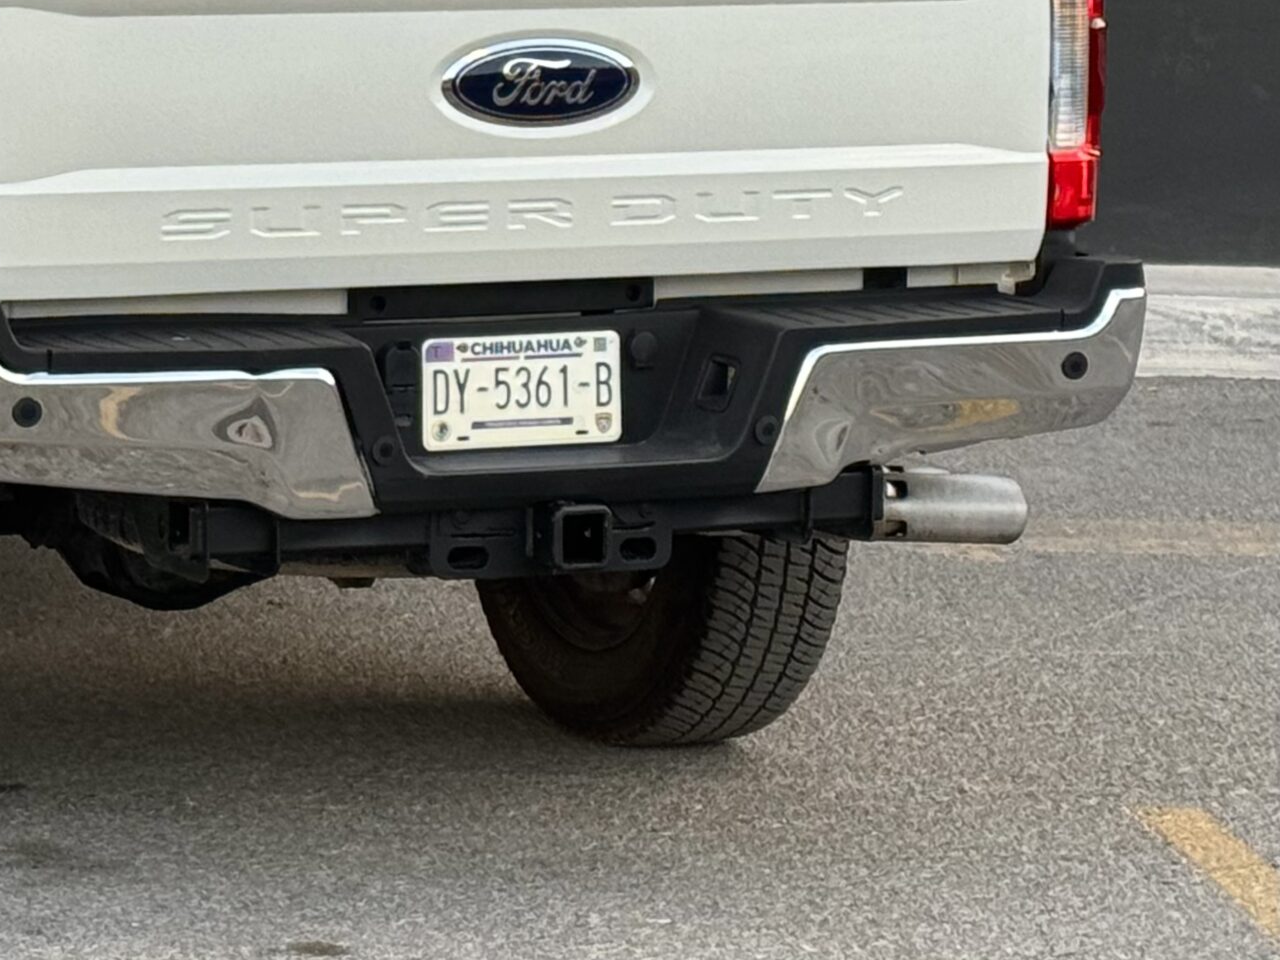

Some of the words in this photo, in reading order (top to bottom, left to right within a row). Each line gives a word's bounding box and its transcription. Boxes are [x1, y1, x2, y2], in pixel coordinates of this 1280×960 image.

[492, 57, 596, 106] Ford
[161, 197, 573, 241] SUPER
[610, 186, 904, 226] DUTY
[470, 338, 573, 356] CHIHUAHUA
[432, 361, 613, 415] DY-5361-B
